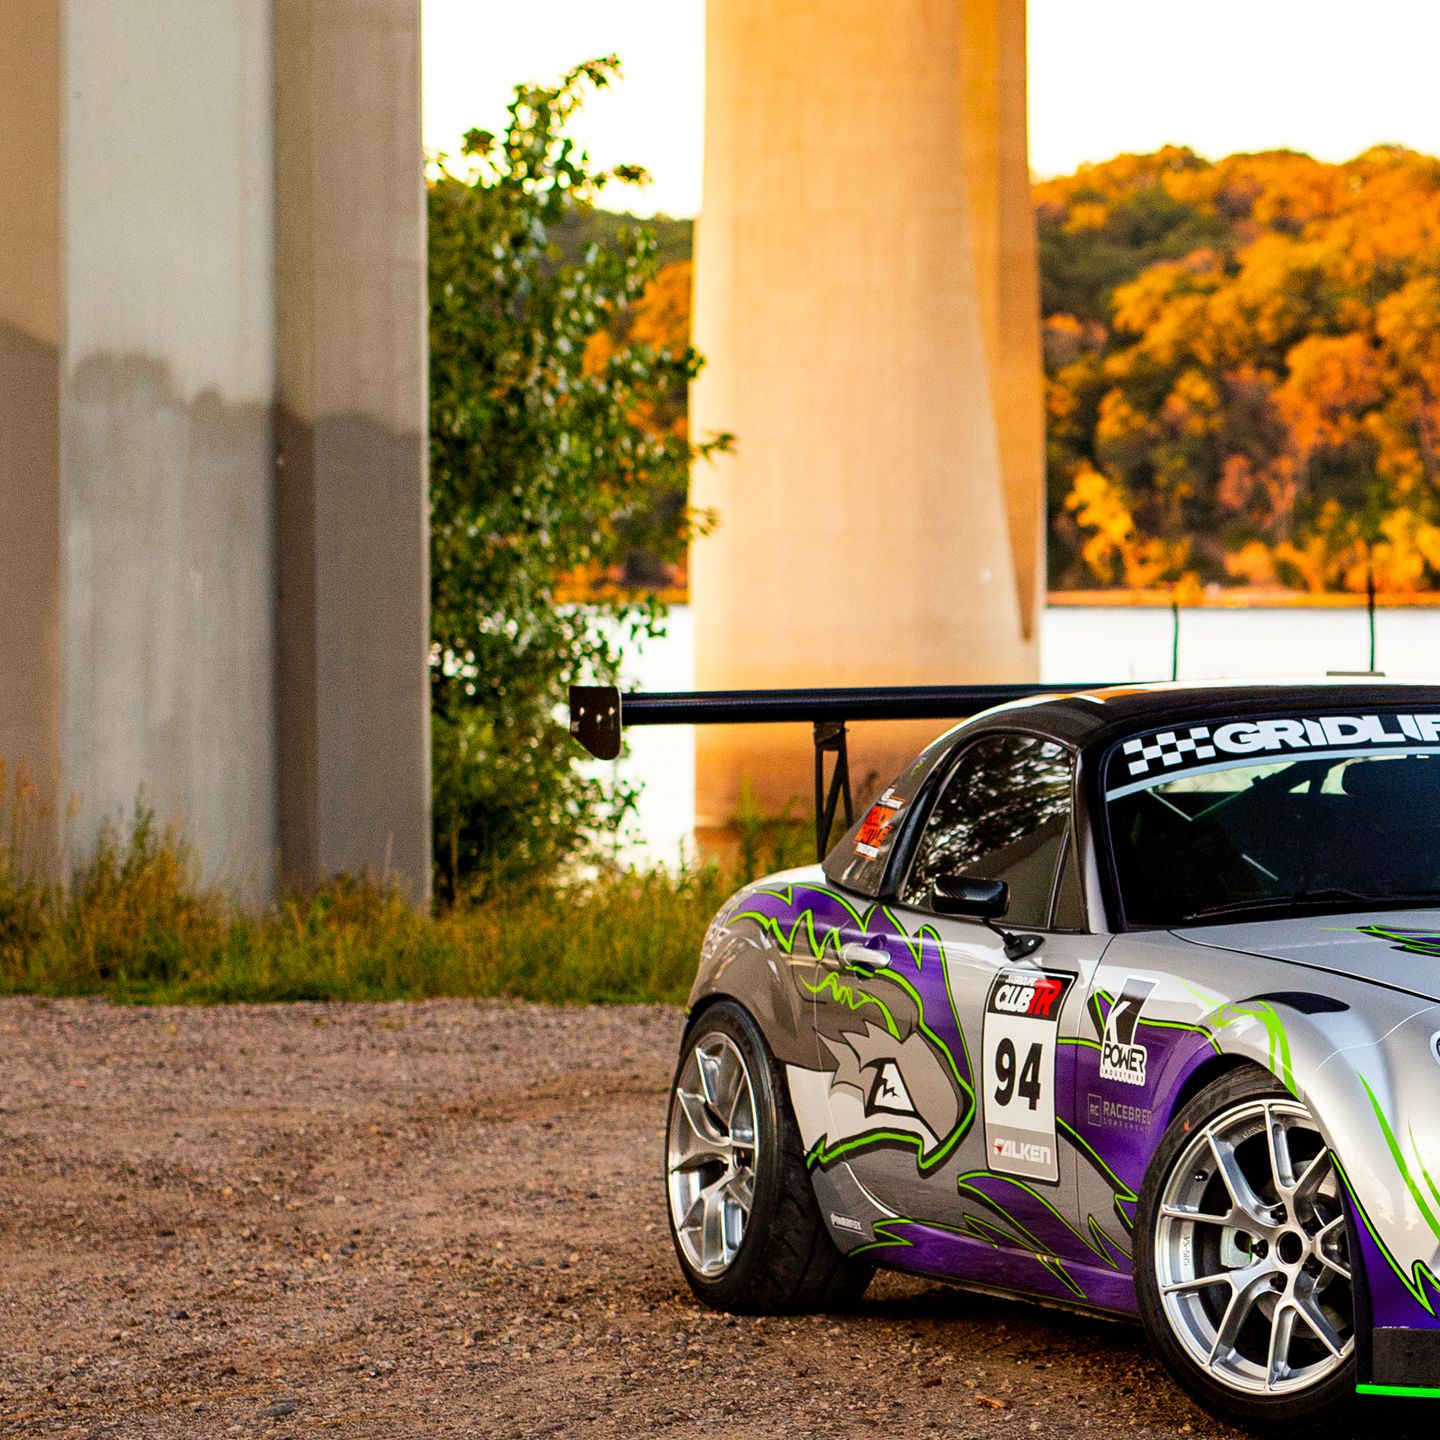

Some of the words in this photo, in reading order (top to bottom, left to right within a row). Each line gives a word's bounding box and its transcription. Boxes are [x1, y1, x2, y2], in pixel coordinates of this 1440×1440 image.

[1103, 1043, 1144, 1073] POWER
[994, 1037, 1043, 1111] 94
[1101, 1067, 1144, 1083] INDUSTRIES
[1103, 1101, 1153, 1125] RACEBRED
[994, 1137, 1051, 1164] FALKEN
